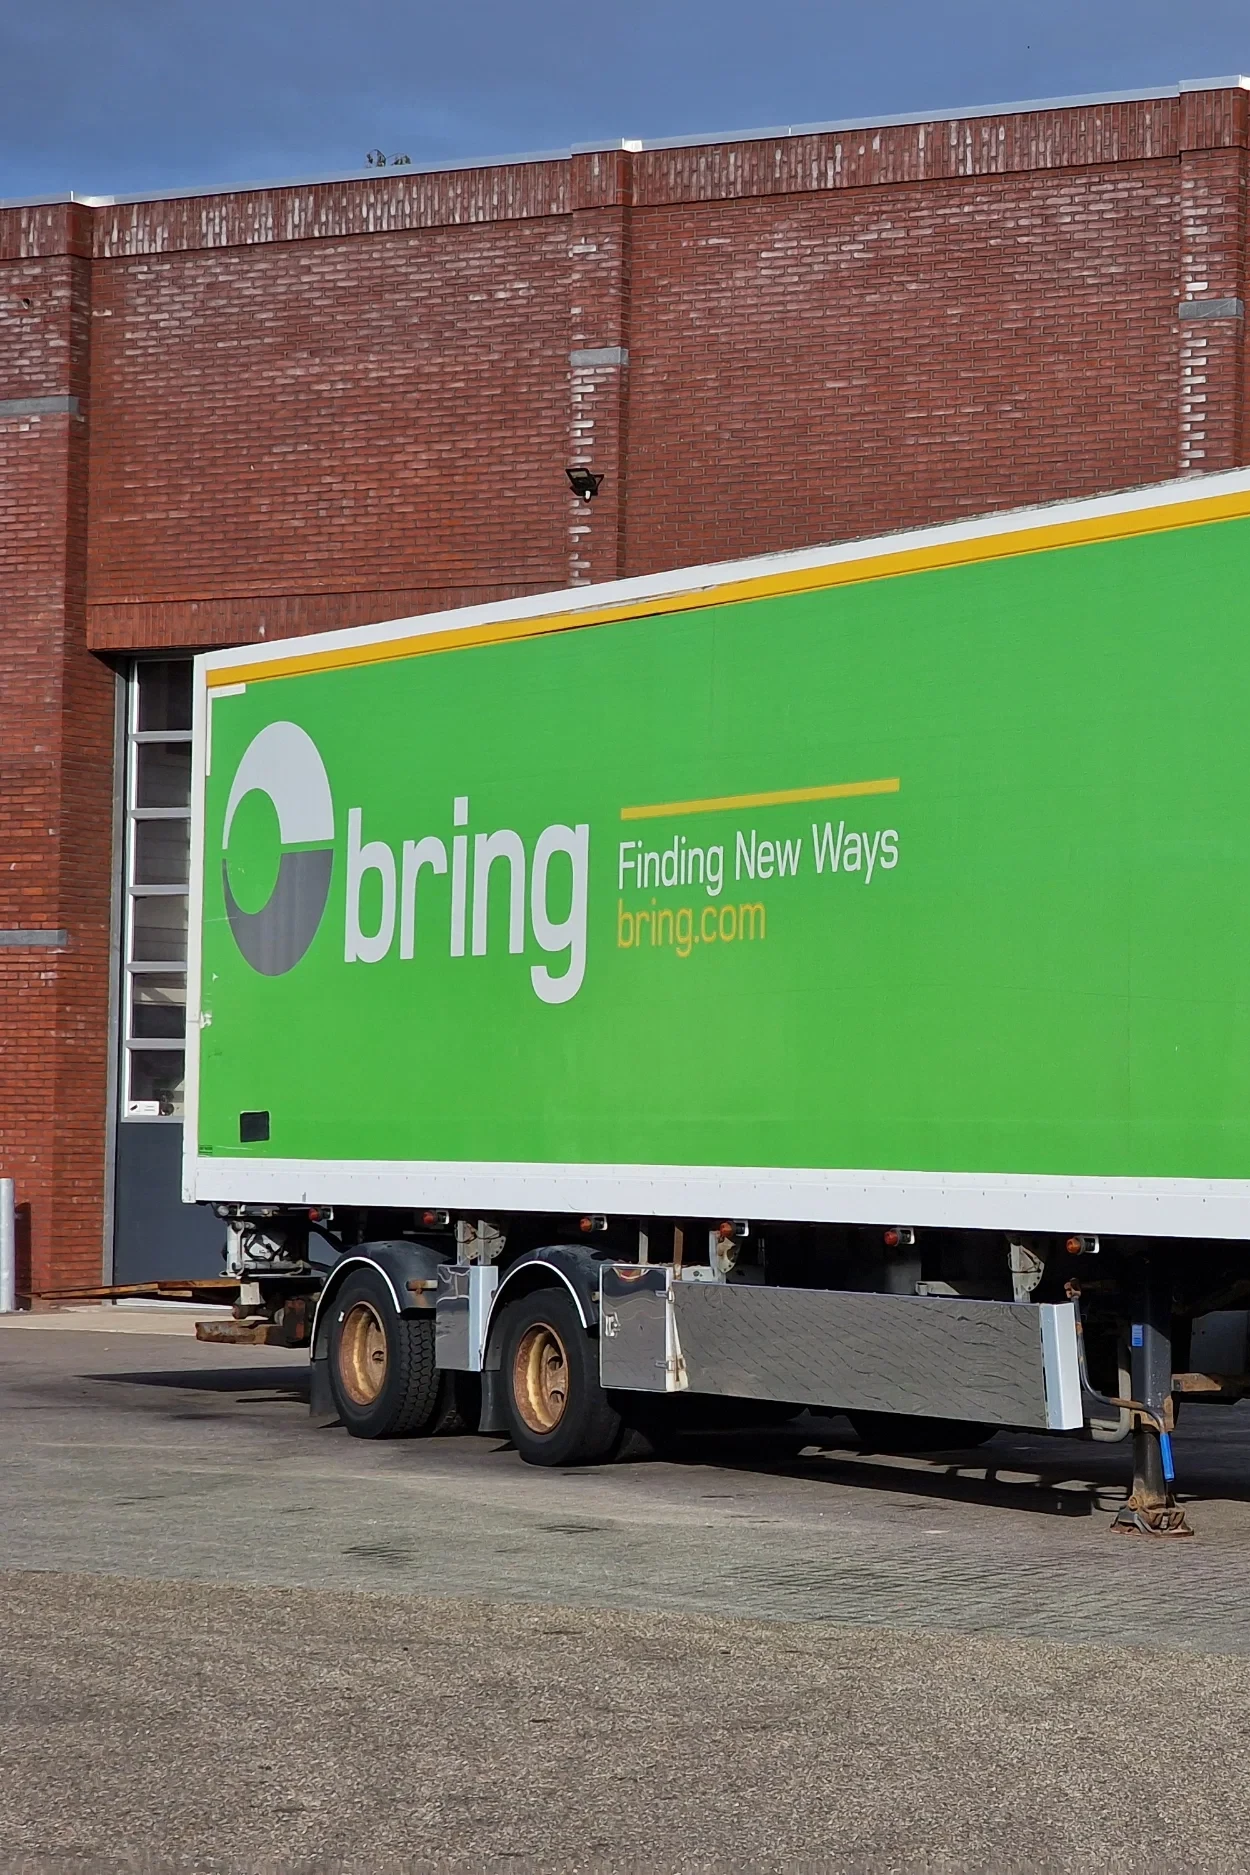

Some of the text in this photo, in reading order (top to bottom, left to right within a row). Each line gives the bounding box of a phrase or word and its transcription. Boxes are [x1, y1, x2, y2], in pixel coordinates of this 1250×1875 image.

[618, 820, 899, 897] Finding New Ways
[344, 795, 590, 1004] bring
[617, 897, 766, 958] bring.com
